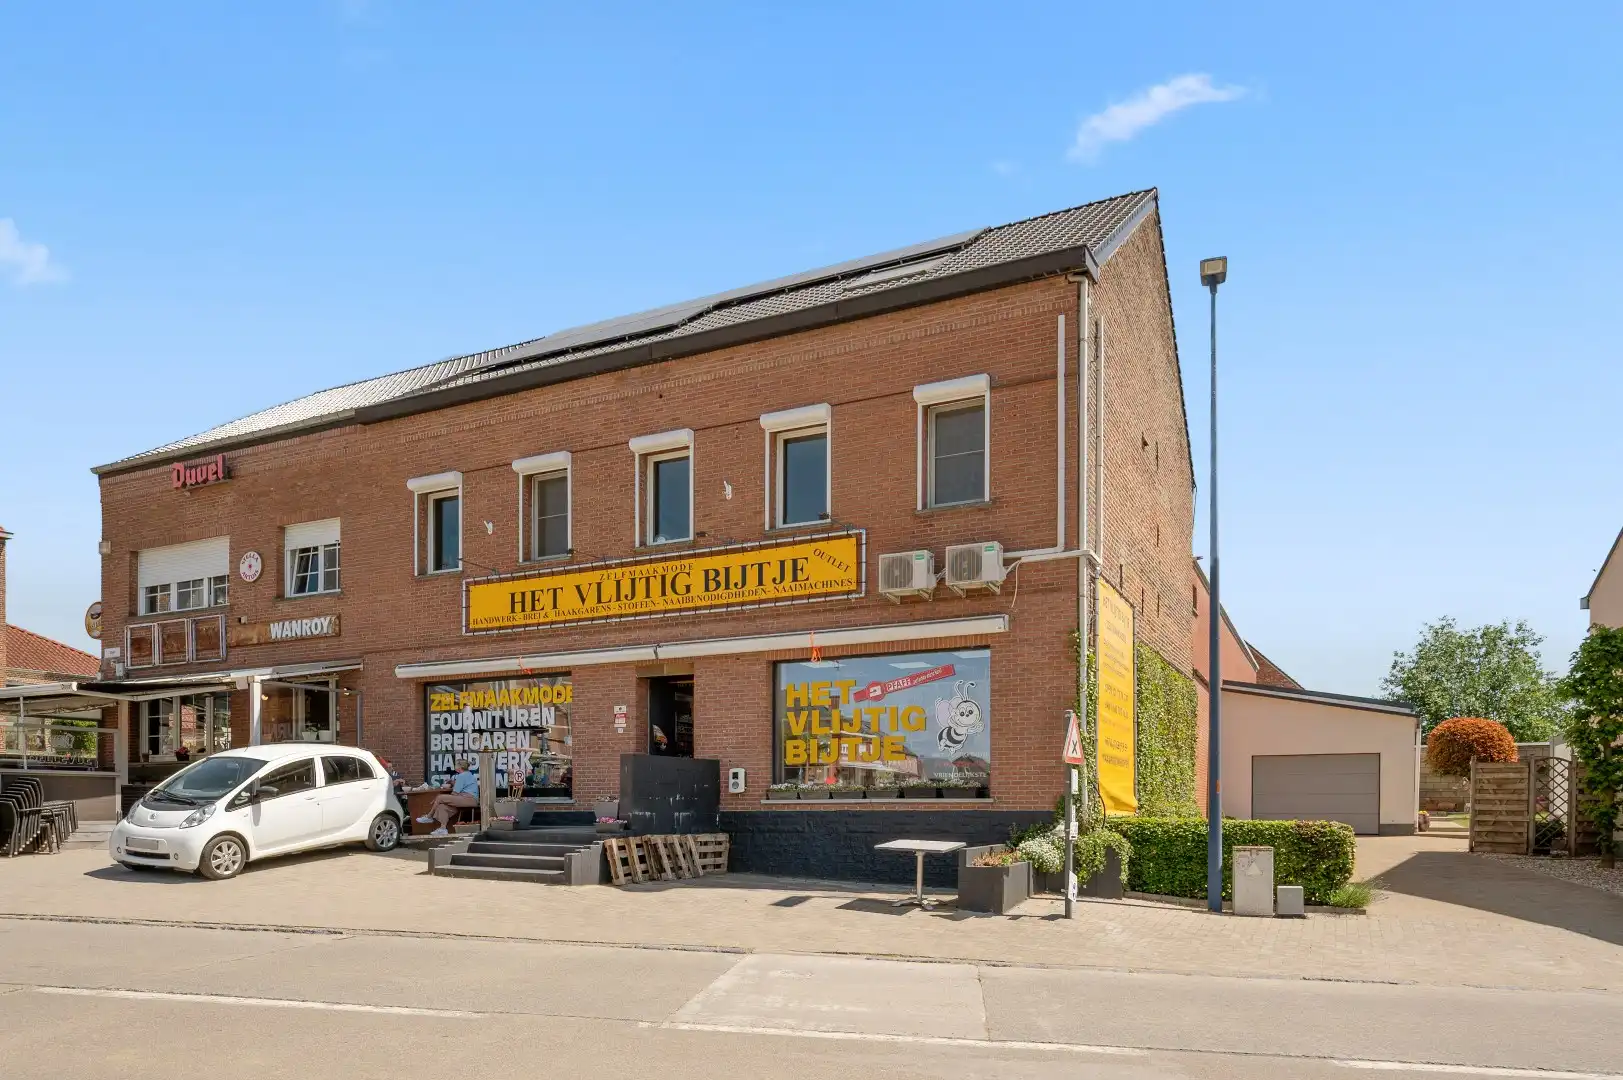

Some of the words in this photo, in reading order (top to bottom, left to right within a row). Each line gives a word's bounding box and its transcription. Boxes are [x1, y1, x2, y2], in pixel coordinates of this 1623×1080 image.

[171, 454, 224, 488] Duvel
[241, 553, 259, 565] STELLA
[599, 562, 694, 581] ZELFMAAKMODE
[813, 548, 851, 573] OUTLET
[509, 586, 564, 614] HET
[573, 572, 692, 606] VLIJTIG
[702, 557, 810, 593] BIJTJE
[270, 617, 331, 640] WANROY
[785, 679, 857, 708] HET
[886, 677, 912, 692] PFAFF
[430, 684, 573, 711] ZELFMAAKMODE
[430, 707, 556, 731] FOURNITUREN
[786, 705, 927, 736] VLIJTIG
[430, 730, 530, 752] BREIGAREN
[784, 735, 906, 766] BIJTJE
